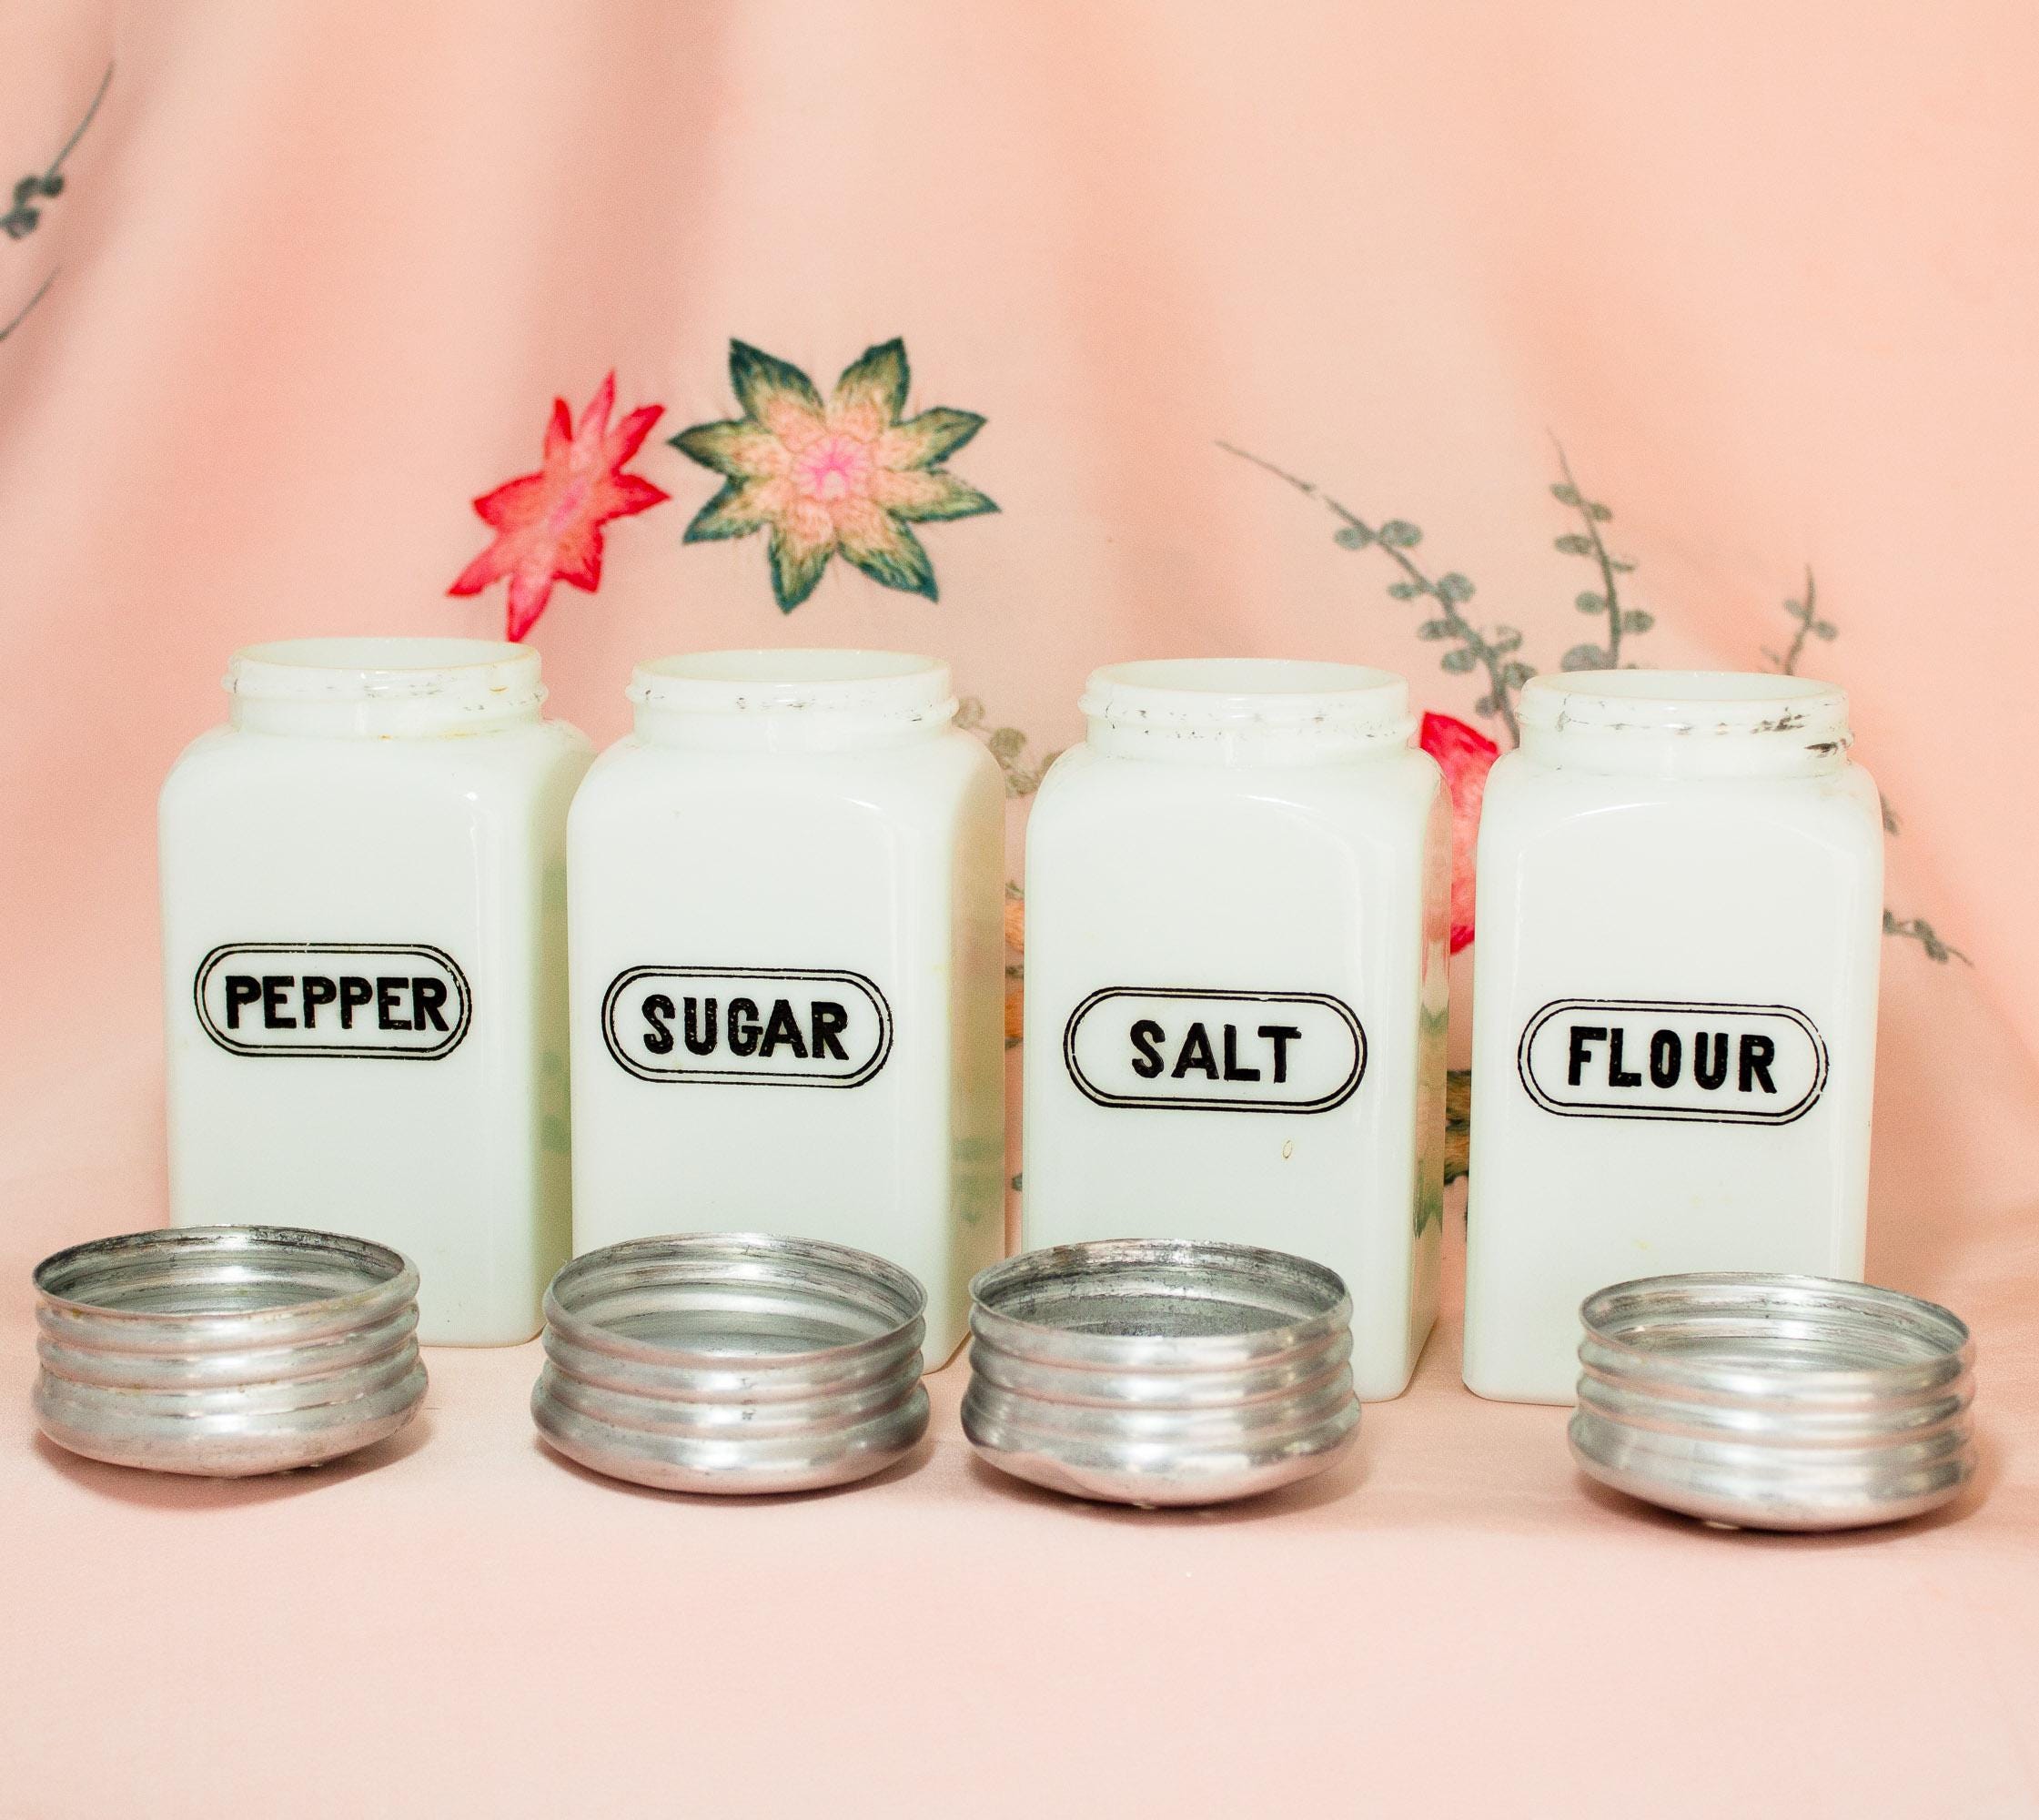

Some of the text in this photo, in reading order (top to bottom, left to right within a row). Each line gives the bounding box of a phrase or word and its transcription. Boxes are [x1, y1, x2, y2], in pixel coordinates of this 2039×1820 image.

[225, 975, 449, 1032] PEPPER
[641, 994, 850, 1061] SUGAR
[1129, 1019, 1302, 1085] SALT
[1568, 1026, 1778, 1095] FLOUR
